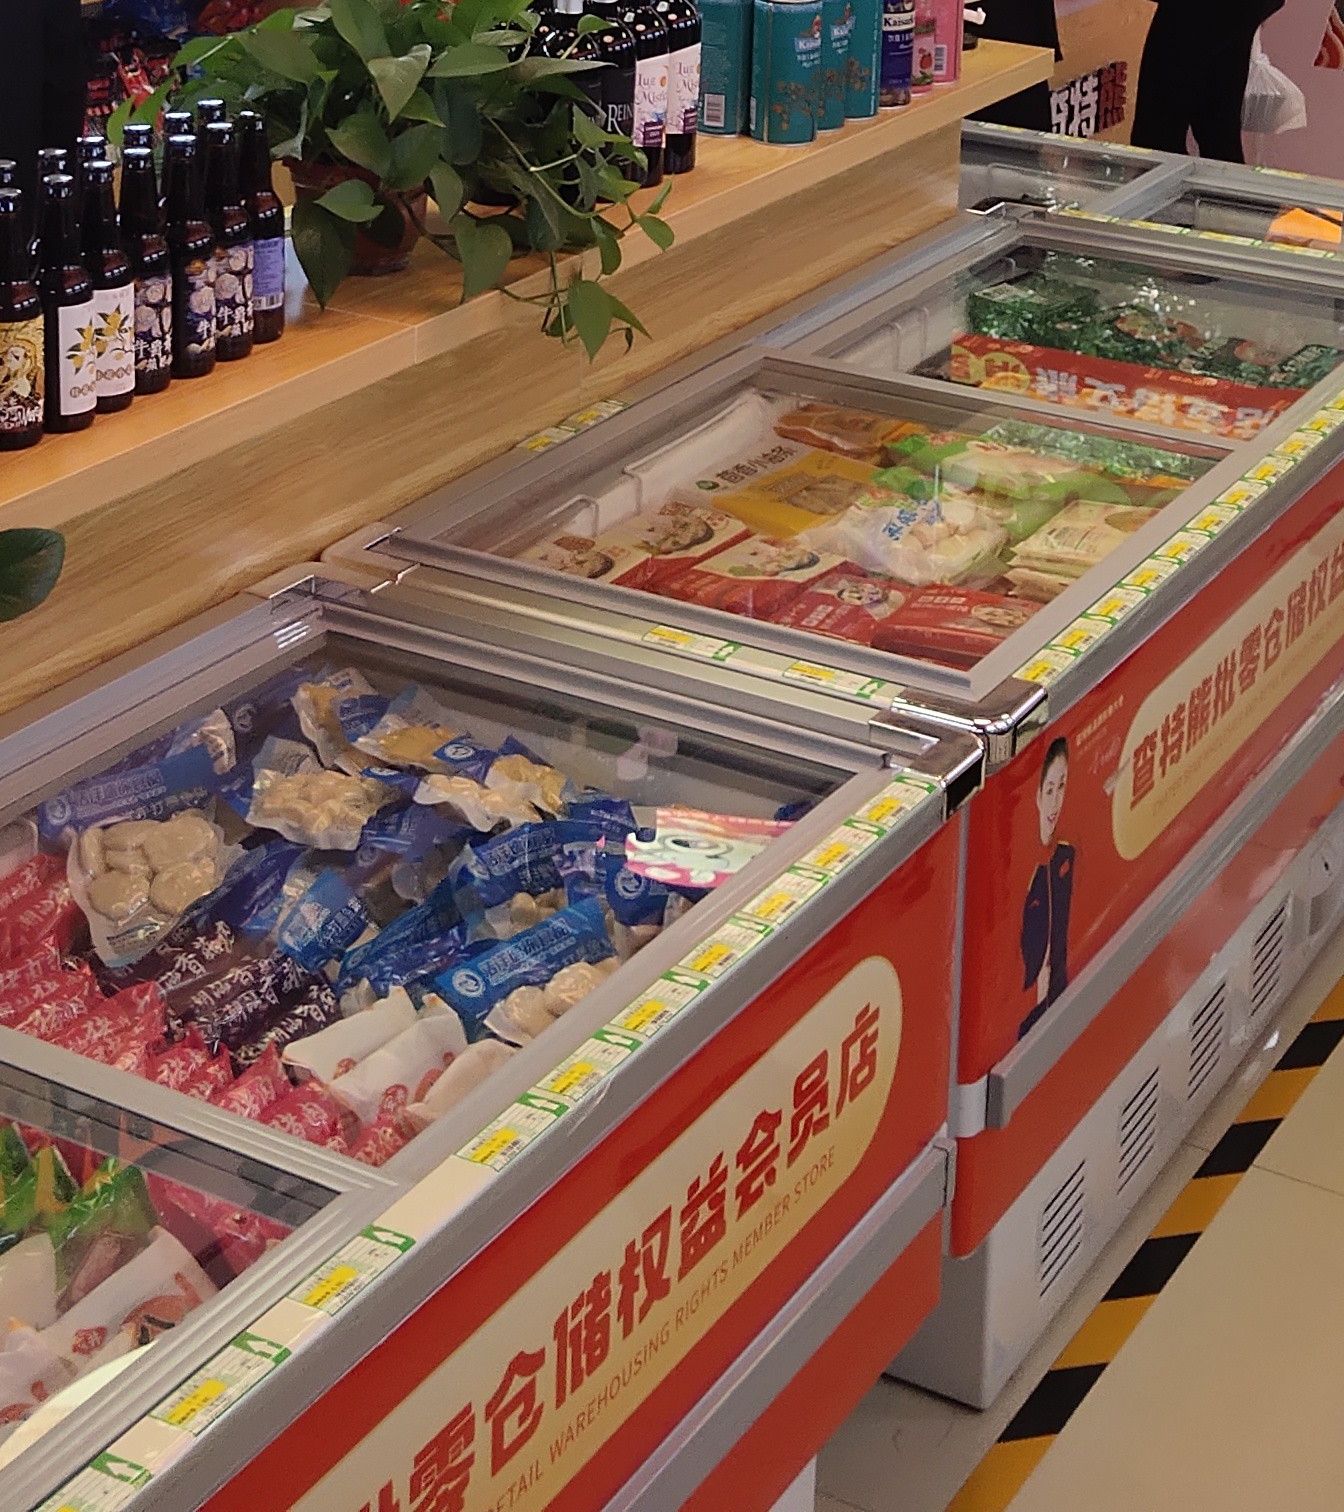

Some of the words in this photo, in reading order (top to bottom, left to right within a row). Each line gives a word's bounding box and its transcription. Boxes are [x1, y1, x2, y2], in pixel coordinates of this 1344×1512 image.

[549, 1325, 671, 1465] WAREHOUSING
[674, 1264, 728, 1332] RIGHTS
[732, 1196, 792, 1268] MEMBER
[793, 1146, 836, 1205] STORE
